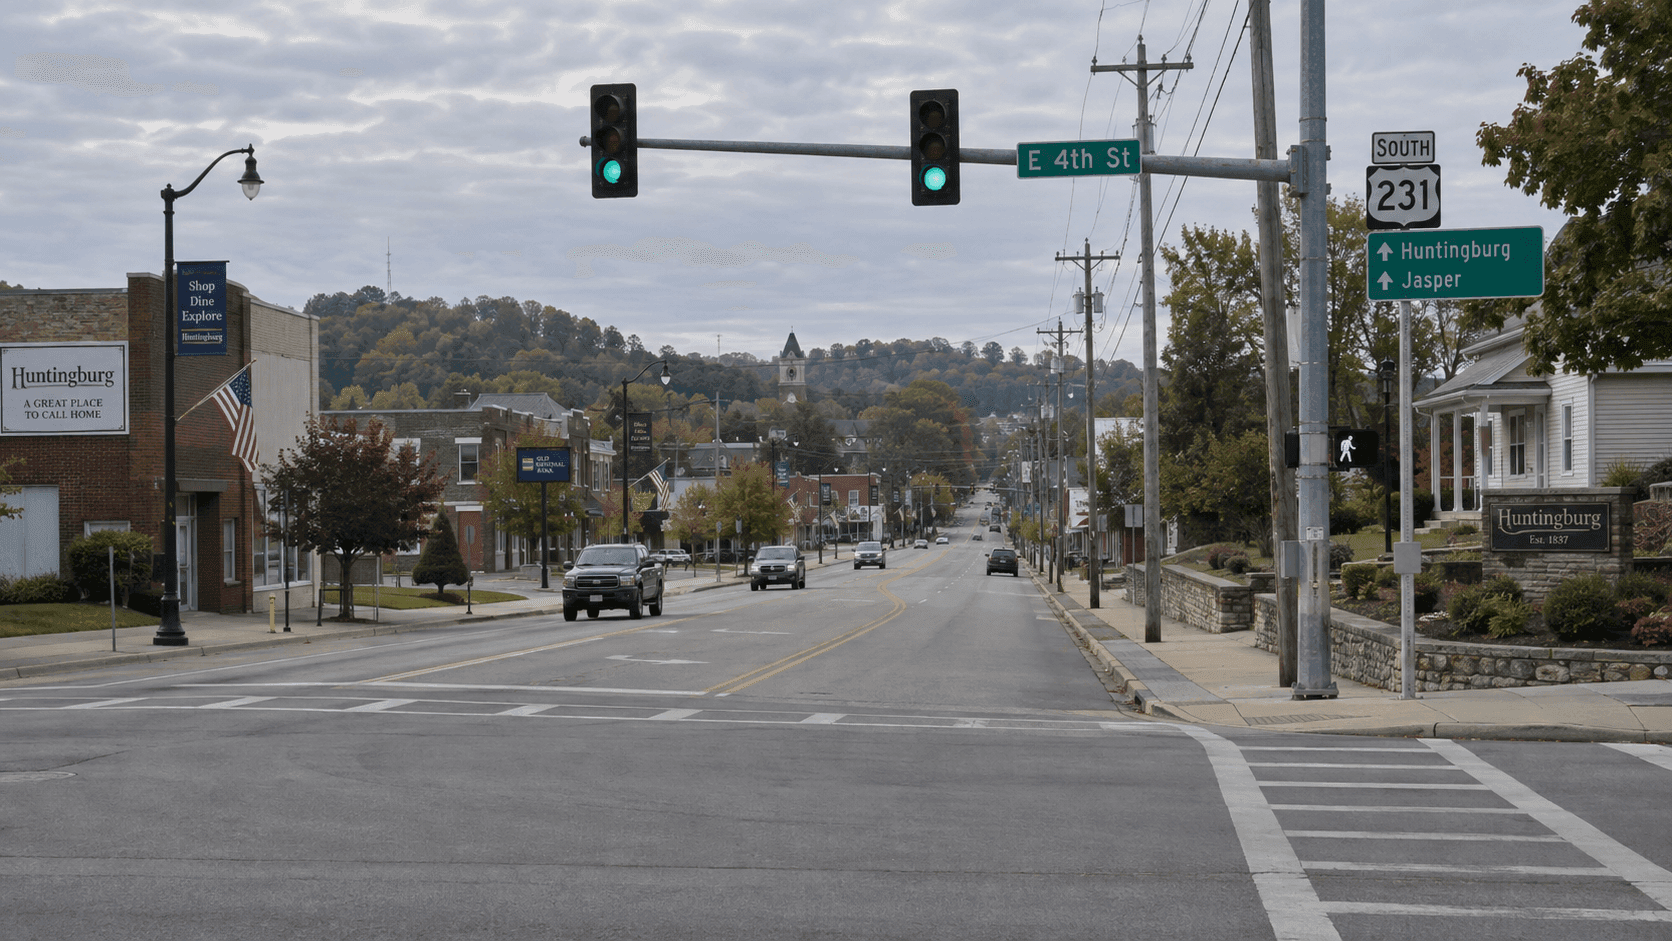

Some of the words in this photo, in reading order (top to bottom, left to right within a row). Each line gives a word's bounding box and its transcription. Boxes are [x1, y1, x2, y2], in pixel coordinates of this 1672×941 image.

[1377, 138, 1430, 157] SOUTH
[1029, 150, 1042, 170] E
[1054, 148, 1093, 170] 4th
[1107, 147, 1130, 168] St
[1378, 180, 1428, 212] 231
[1402, 240, 1511, 263] Huntingburg
[189, 280, 215, 294] Shop
[1402, 271, 1462, 292] Jasper
[190, 295, 215, 306] Dine
[182, 310, 223, 324] Explore
[12, 365, 115, 389] Huntingburg
[24, 399, 31, 408] A
[33, 399, 68, 408] GREAT
[70, 398, 103, 408] PLACE
[25, 410, 39, 419] TO
[42, 410, 68, 419] CALL
[70, 410, 102, 419] HOME
[1497, 507, 1602, 530] Huntingburg
[1530, 535, 1545, 545] Est.
[1548, 535, 1569, 545] 1837
